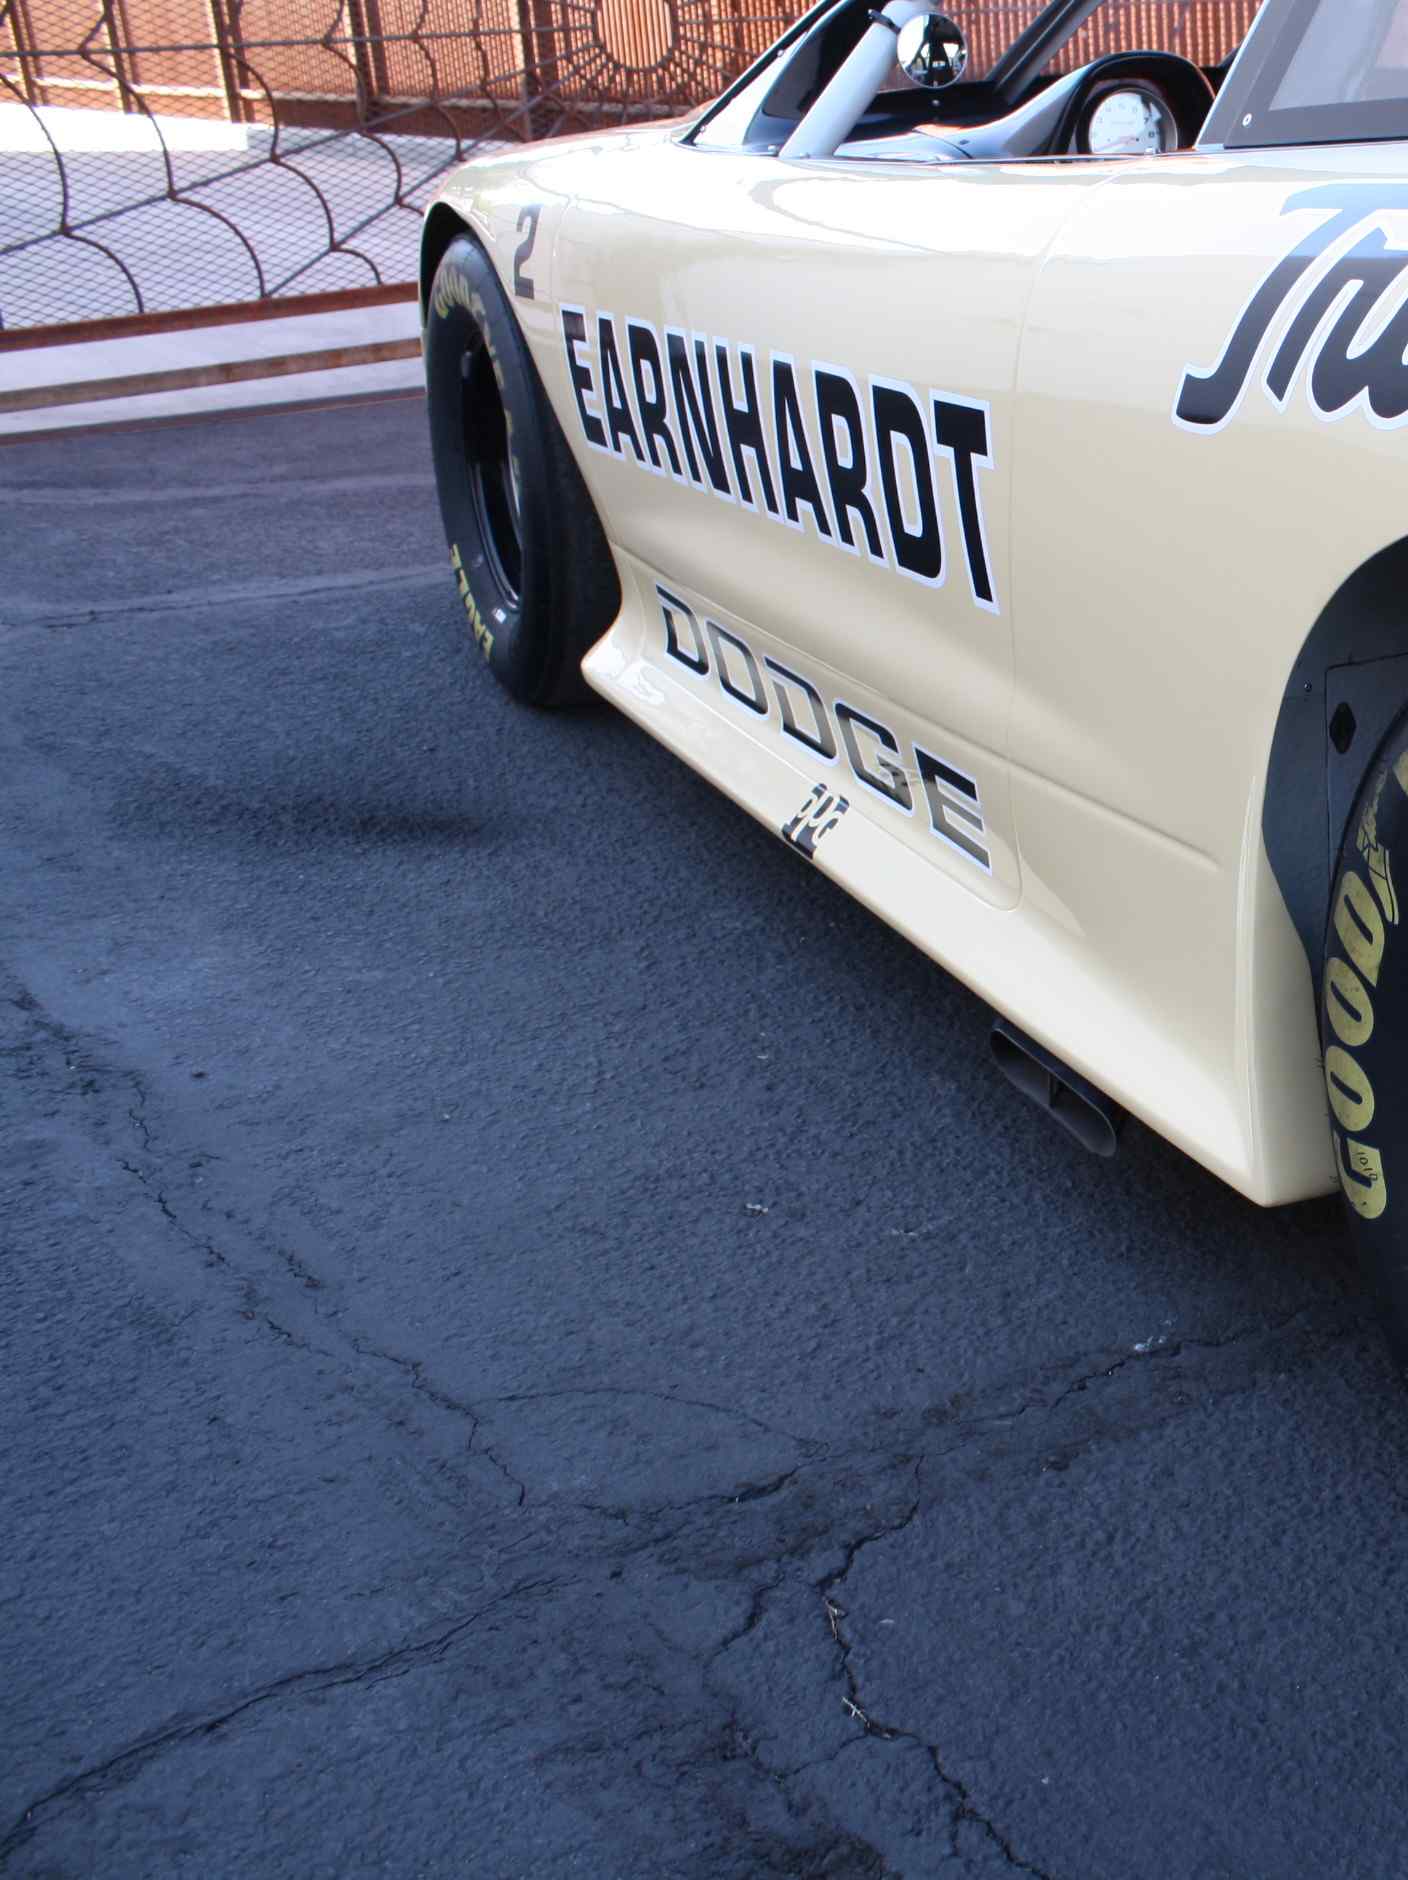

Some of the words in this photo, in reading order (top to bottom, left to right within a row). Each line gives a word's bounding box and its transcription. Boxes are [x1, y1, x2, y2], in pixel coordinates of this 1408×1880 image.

[514, 203, 542, 300] 2
[559, 304, 1000, 614] EARNHARDT
[655, 583, 993, 877] DODGE
